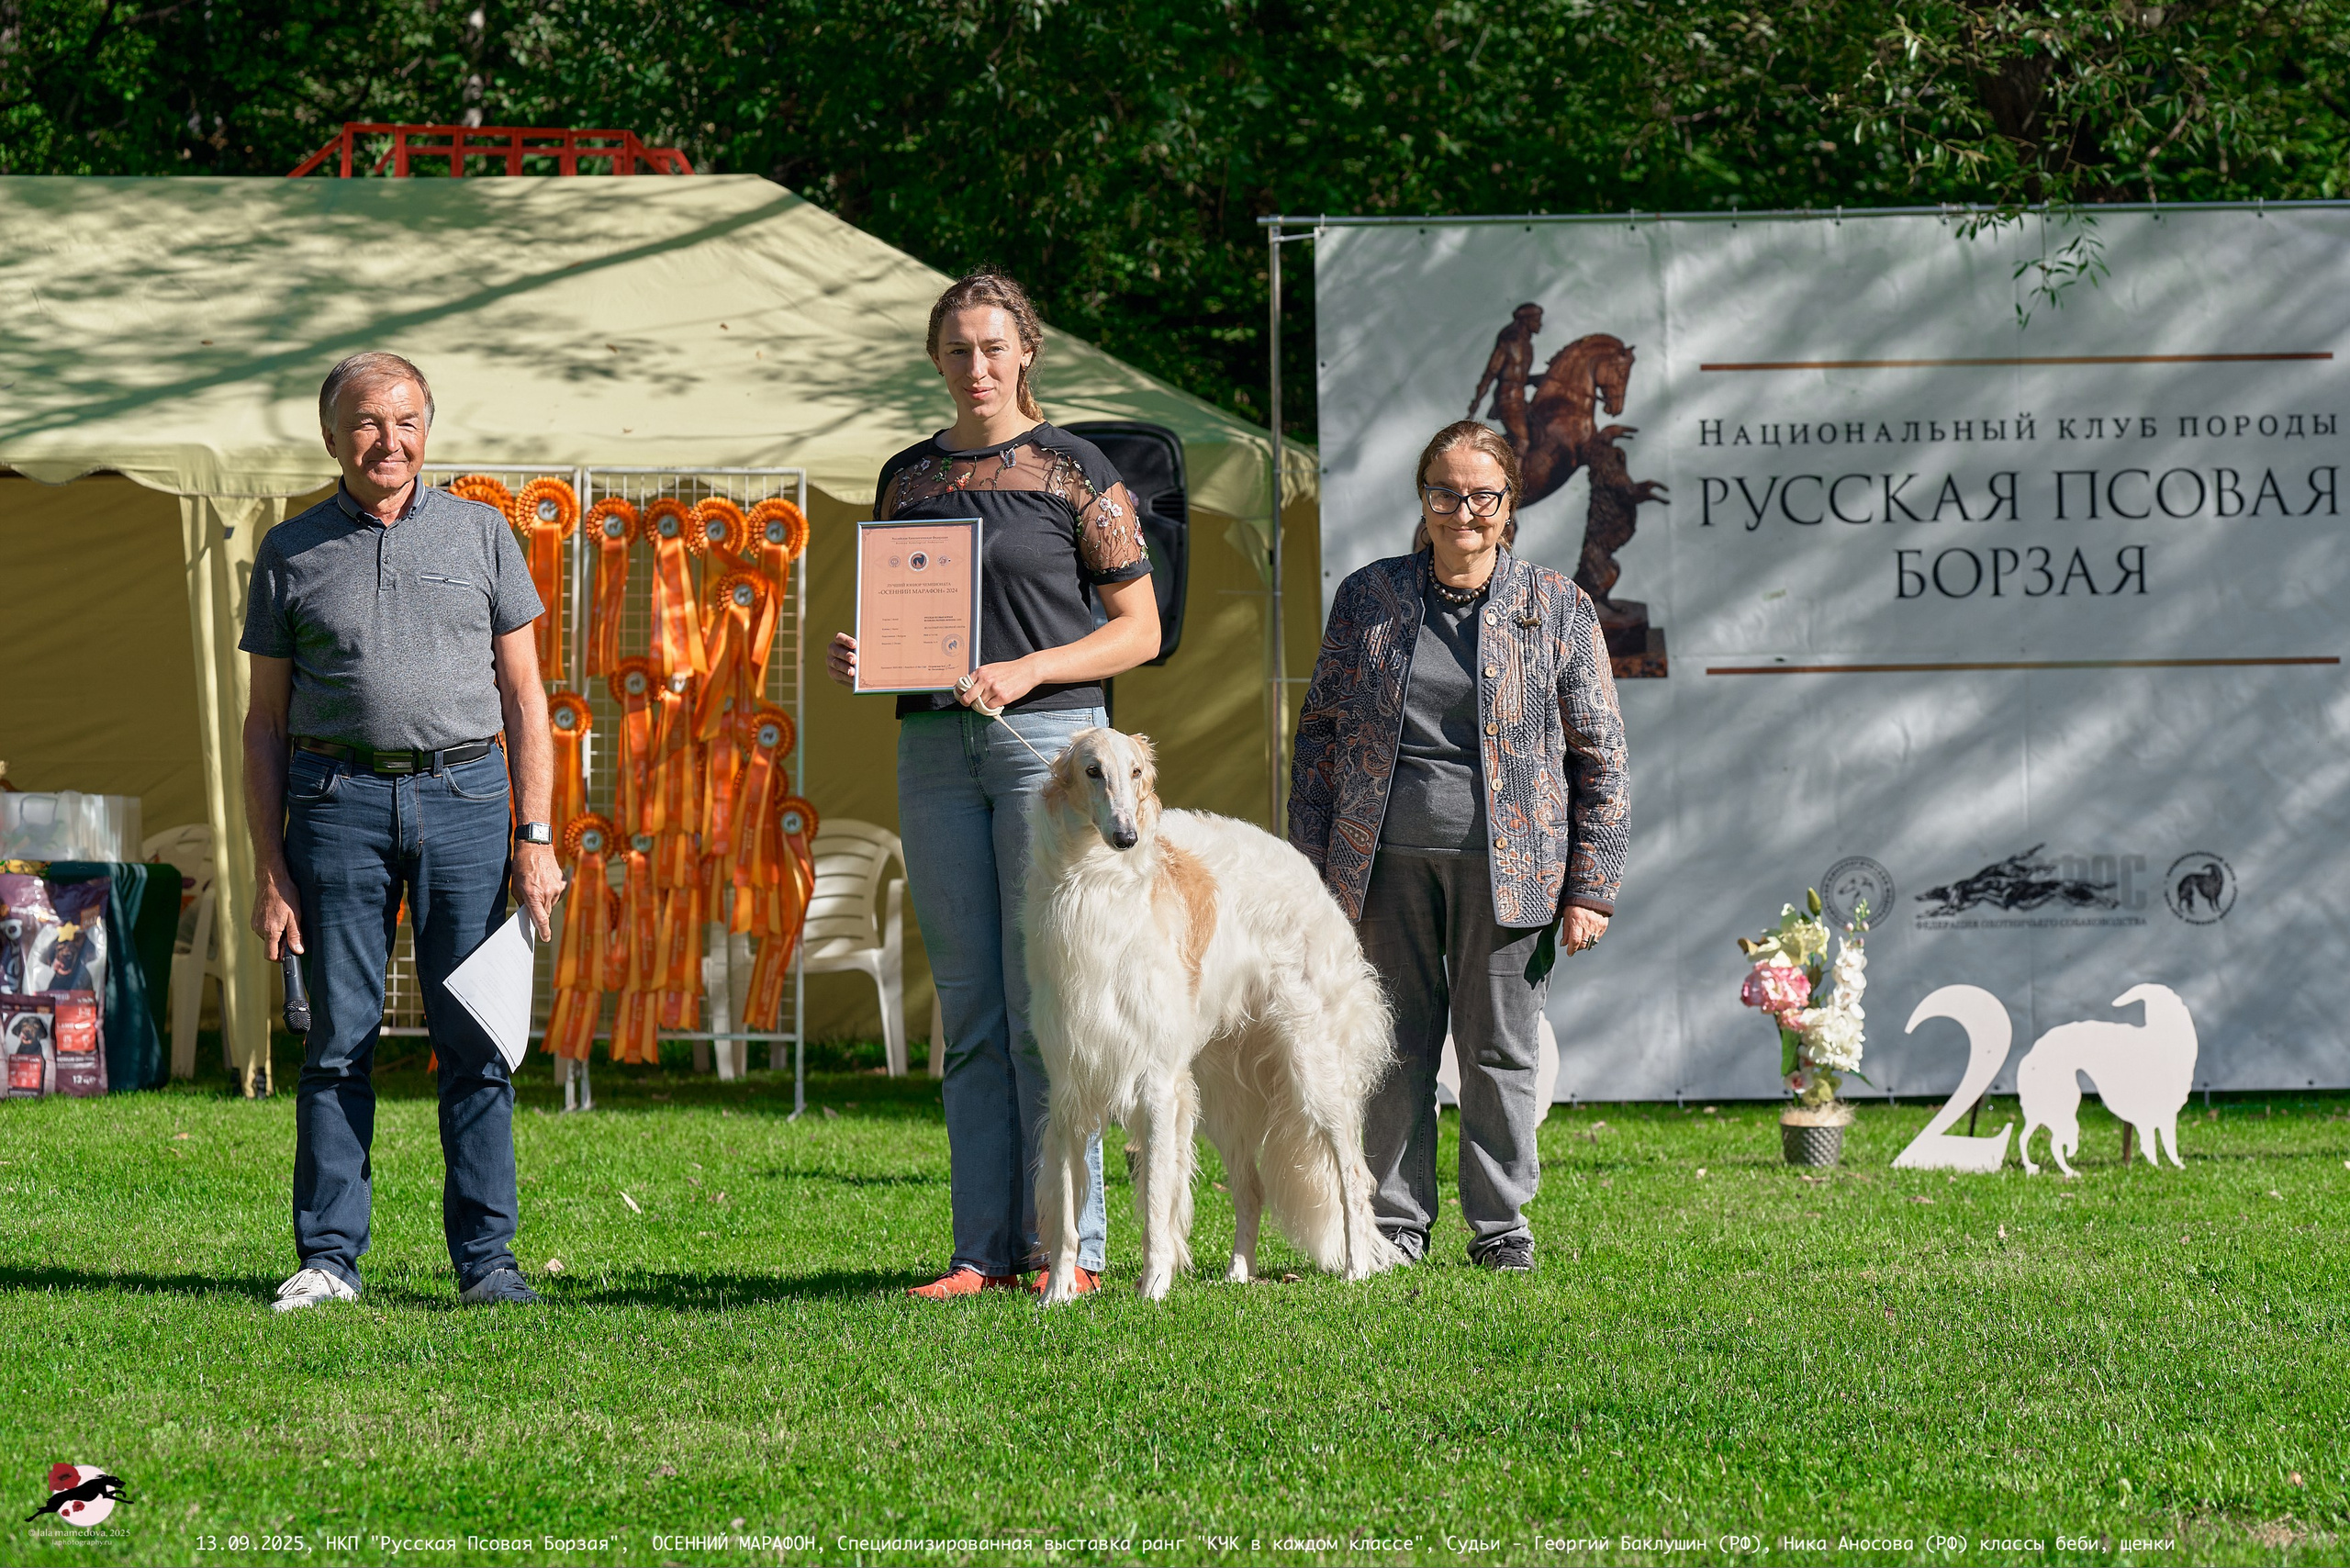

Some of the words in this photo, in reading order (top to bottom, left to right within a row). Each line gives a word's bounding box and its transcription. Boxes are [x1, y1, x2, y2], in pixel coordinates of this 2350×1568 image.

[1698, 469, 2022, 532] РУССКАЯ
[2053, 465, 2342, 521] ПСОВАЯ
[1893, 543, 2151, 600] БОРЗАЯ
